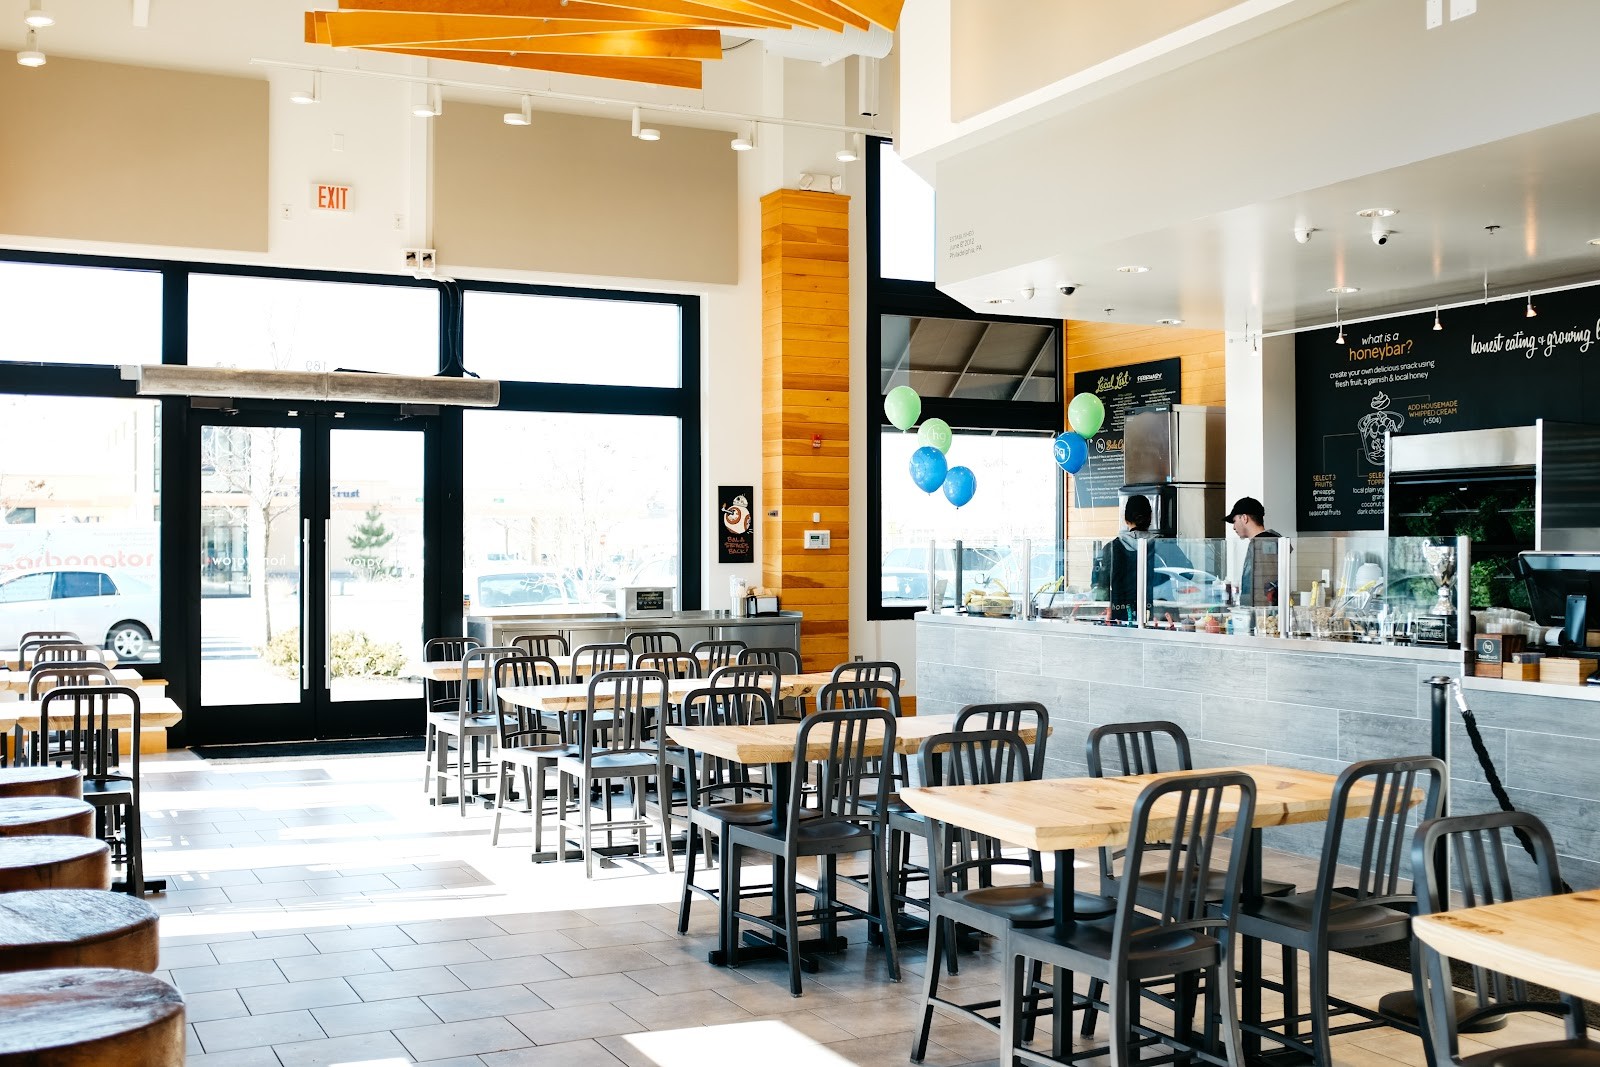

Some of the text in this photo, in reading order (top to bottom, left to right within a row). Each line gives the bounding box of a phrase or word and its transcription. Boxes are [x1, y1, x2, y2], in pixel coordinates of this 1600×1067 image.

[318, 185, 348, 210] EXIT
[950, 230, 974, 242] ESTABLISHED
[1362, 332, 1400, 346] what is a
[1470, 333, 1505, 354] honest
[1505, 330, 1538, 359] eating
[1544, 325, 1594, 358] growing
[1349, 339, 1413, 361] honeybar?
[1330, 360, 1436, 380] create your own delicious snack using
[1095, 371, 1130, 394] Local List
[1335, 379, 1350, 388] fresh
[1368, 376, 1389, 386] garnish
[1388, 374, 1394, 382] &
[1394, 372, 1409, 382] local
[1409, 371, 1429, 380] honey
[1408, 409, 1436, 418] WHIPPED
[1420, 400, 1458, 410] HOUSEMADE
[932, 429, 946, 442] hg
